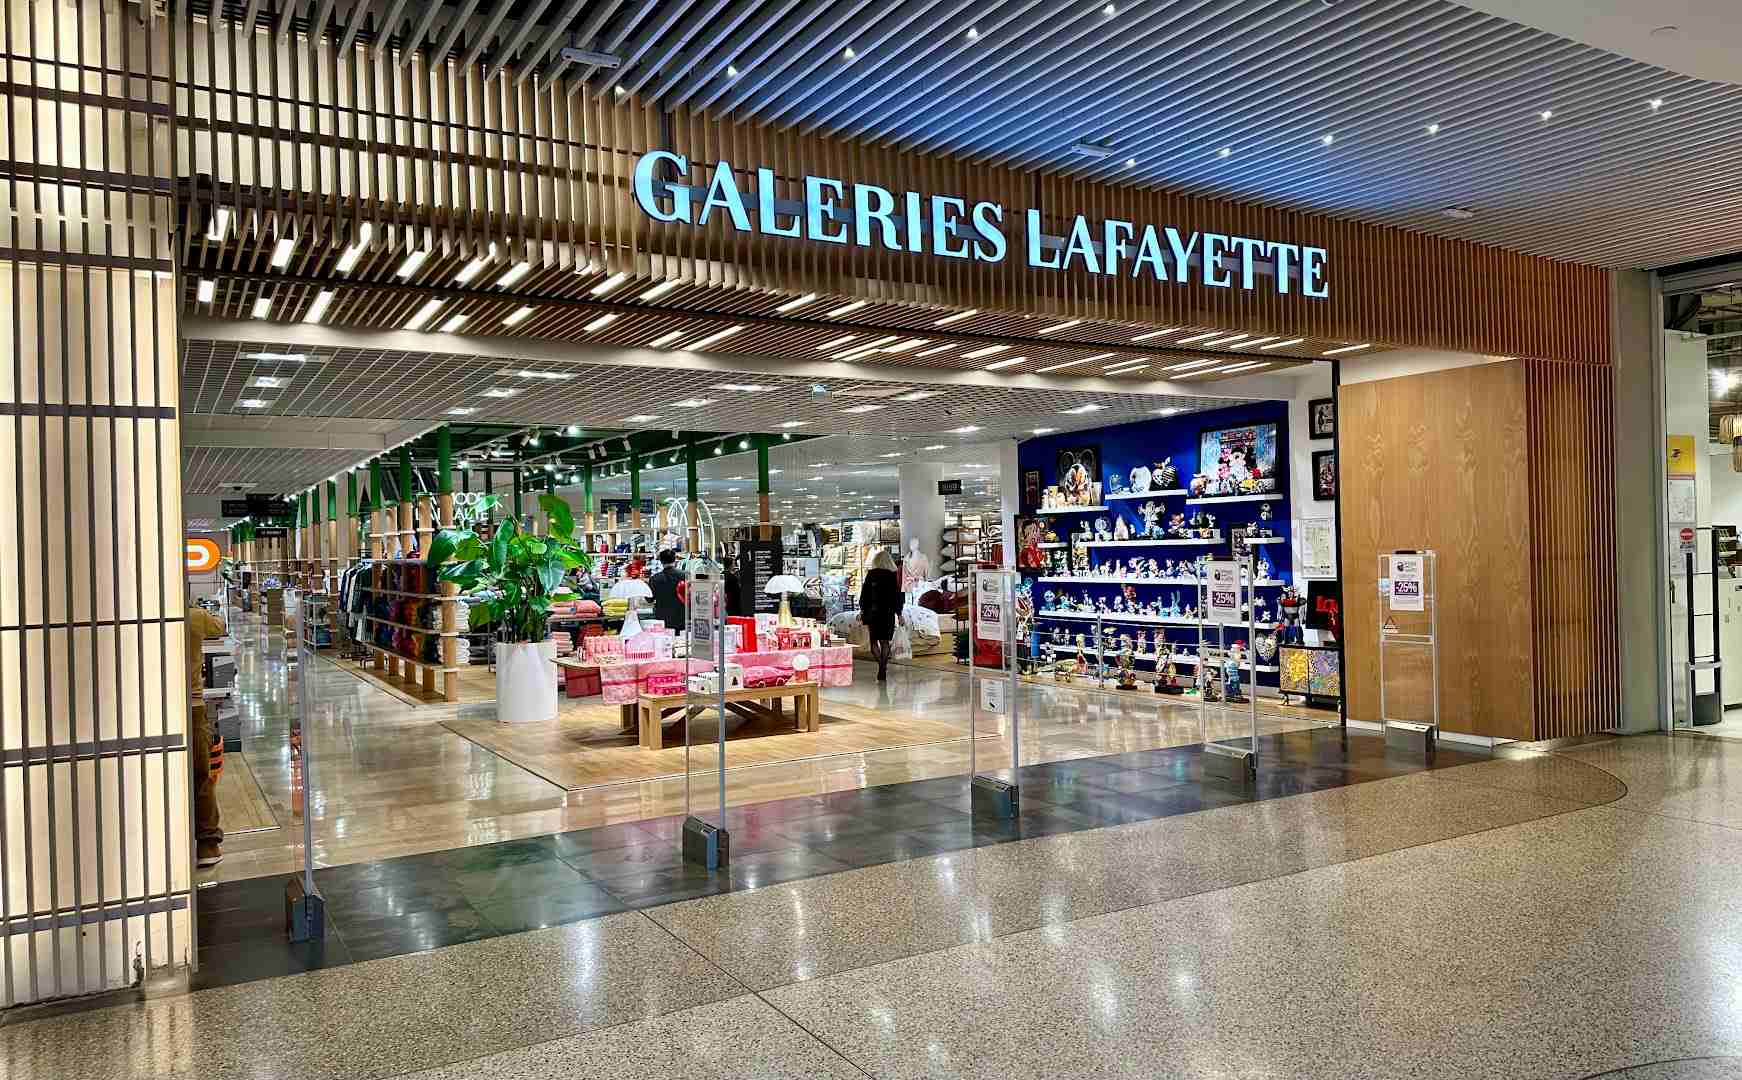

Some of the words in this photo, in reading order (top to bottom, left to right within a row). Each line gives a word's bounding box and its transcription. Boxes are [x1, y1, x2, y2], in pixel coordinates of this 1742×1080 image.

[633, 149, 1007, 263] GALERIES
[1027, 208, 1329, 298] LAFAYETTE
[1394, 582, 1418, 593] -25%
[1213, 592, 1234, 604] -25%
